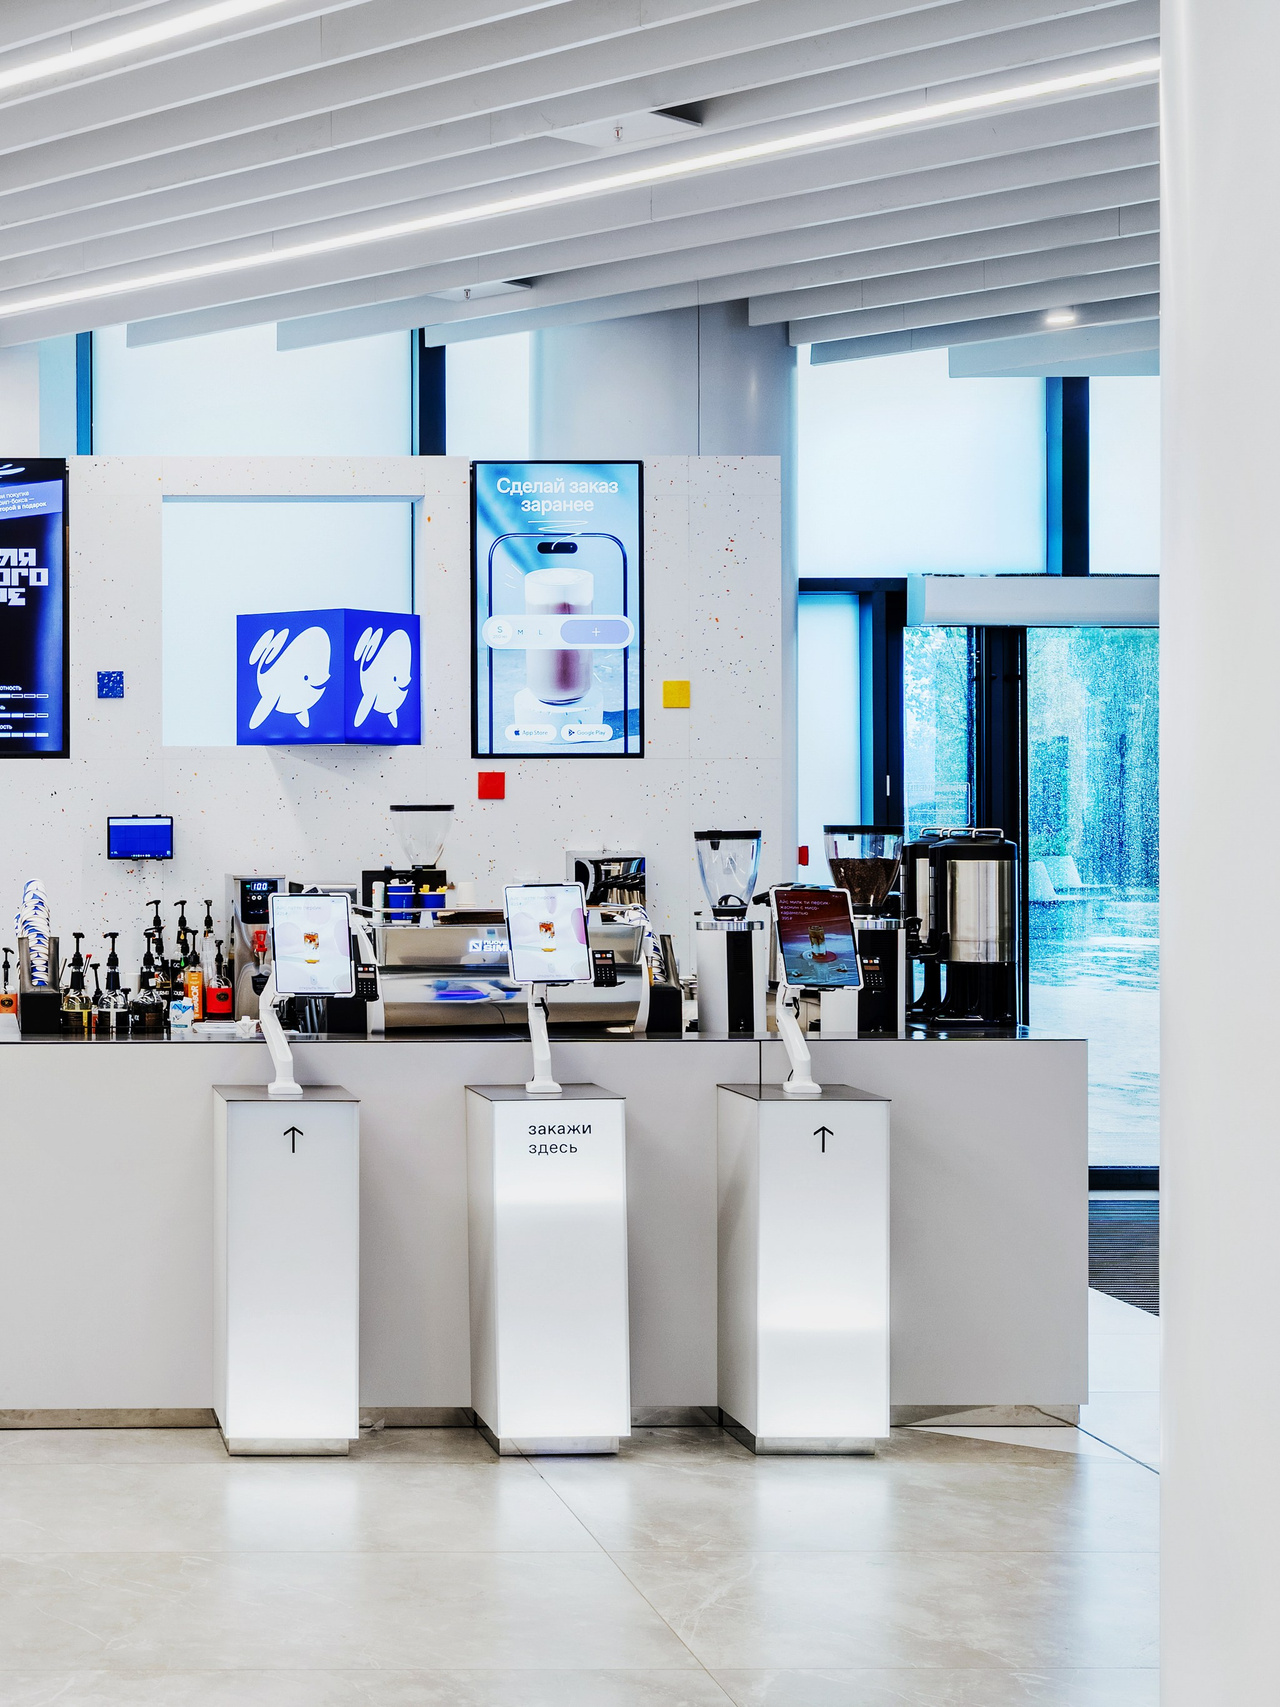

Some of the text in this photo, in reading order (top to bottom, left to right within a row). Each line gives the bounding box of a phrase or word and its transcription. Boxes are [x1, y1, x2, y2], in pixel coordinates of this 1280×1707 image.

[496, 477, 619, 496] Сделай заказ
[521, 499, 594, 515] заранее
[528, 1124, 592, 1136] закажи
[528, 1143, 578, 1156] здесь
